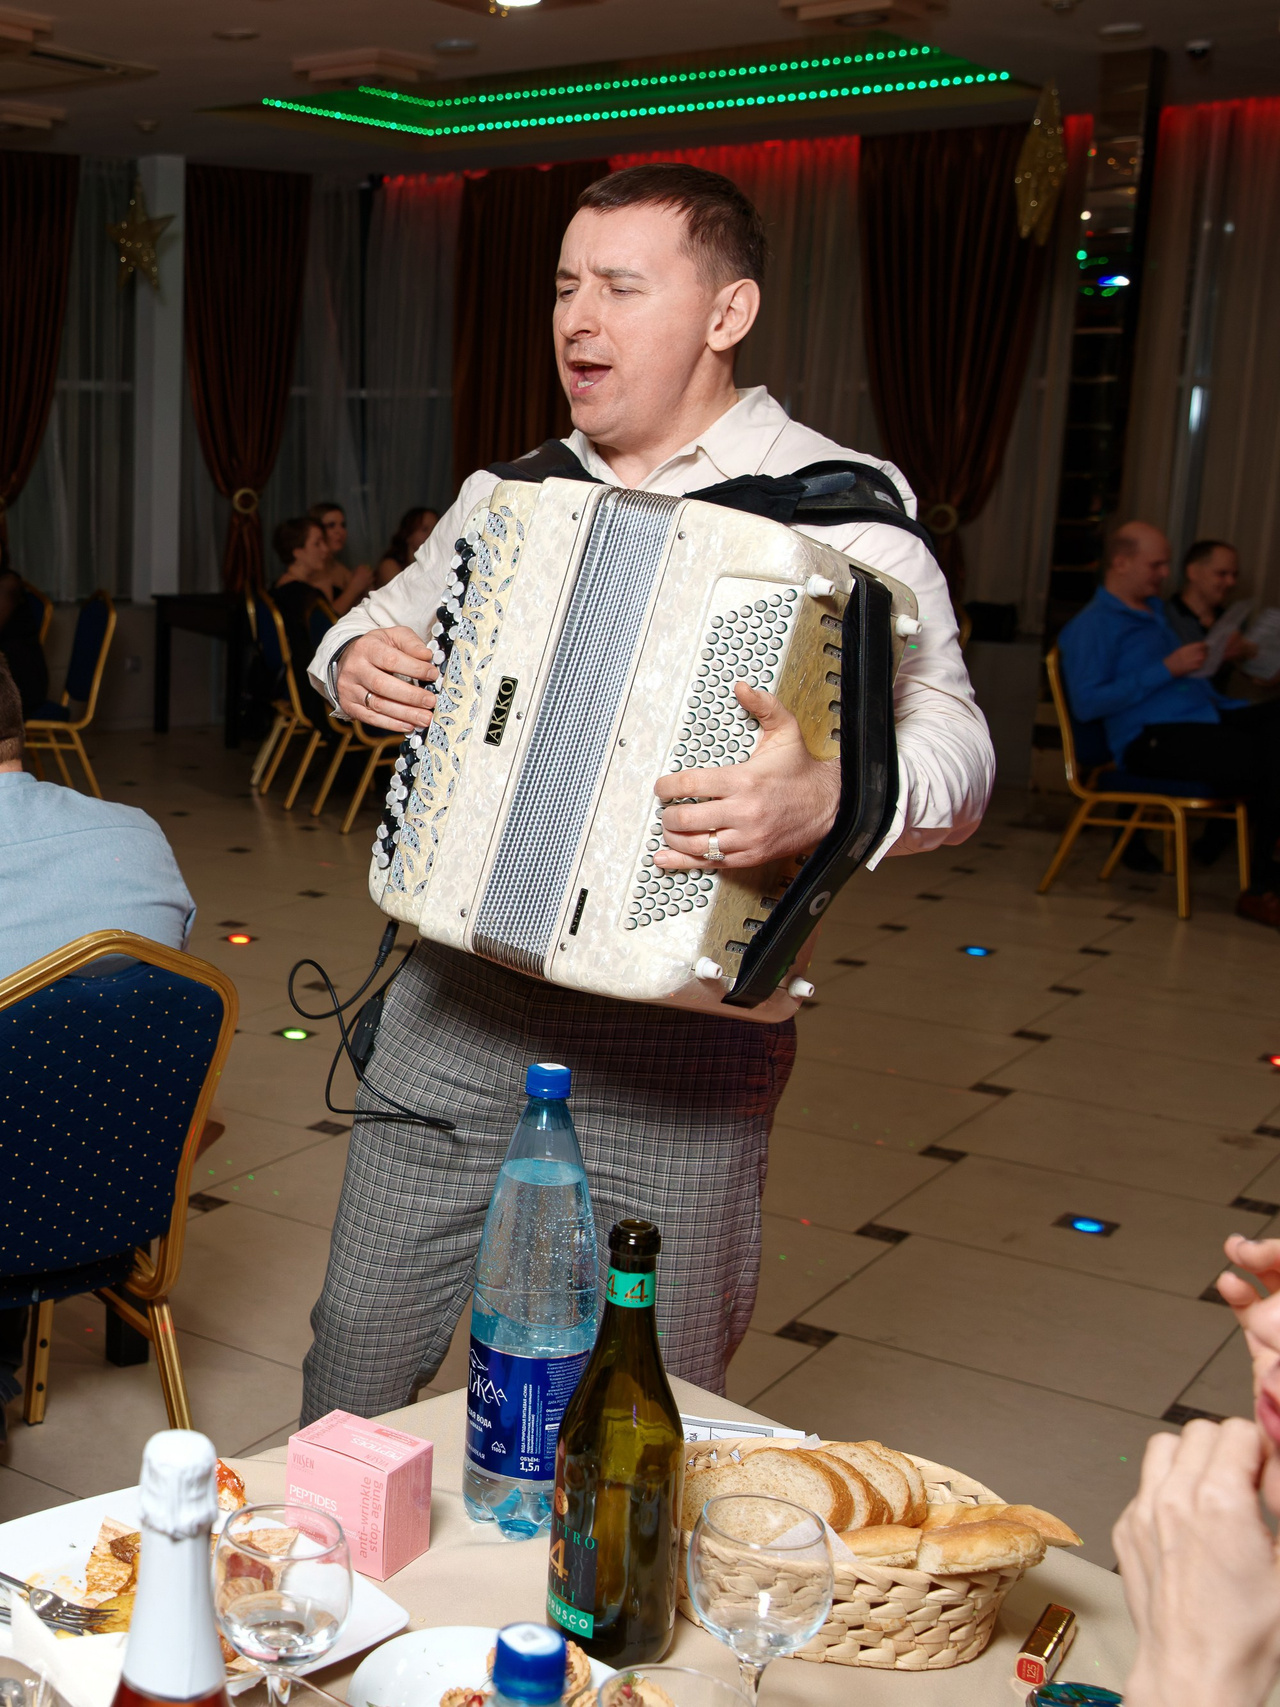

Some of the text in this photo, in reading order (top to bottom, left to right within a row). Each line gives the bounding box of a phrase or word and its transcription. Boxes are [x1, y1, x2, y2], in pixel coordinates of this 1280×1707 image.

[289, 1484, 337, 1511] PEPTIDES
[359, 1476, 372, 1559] anti-wrinkle
[369, 1480, 384, 1553] stop aging
